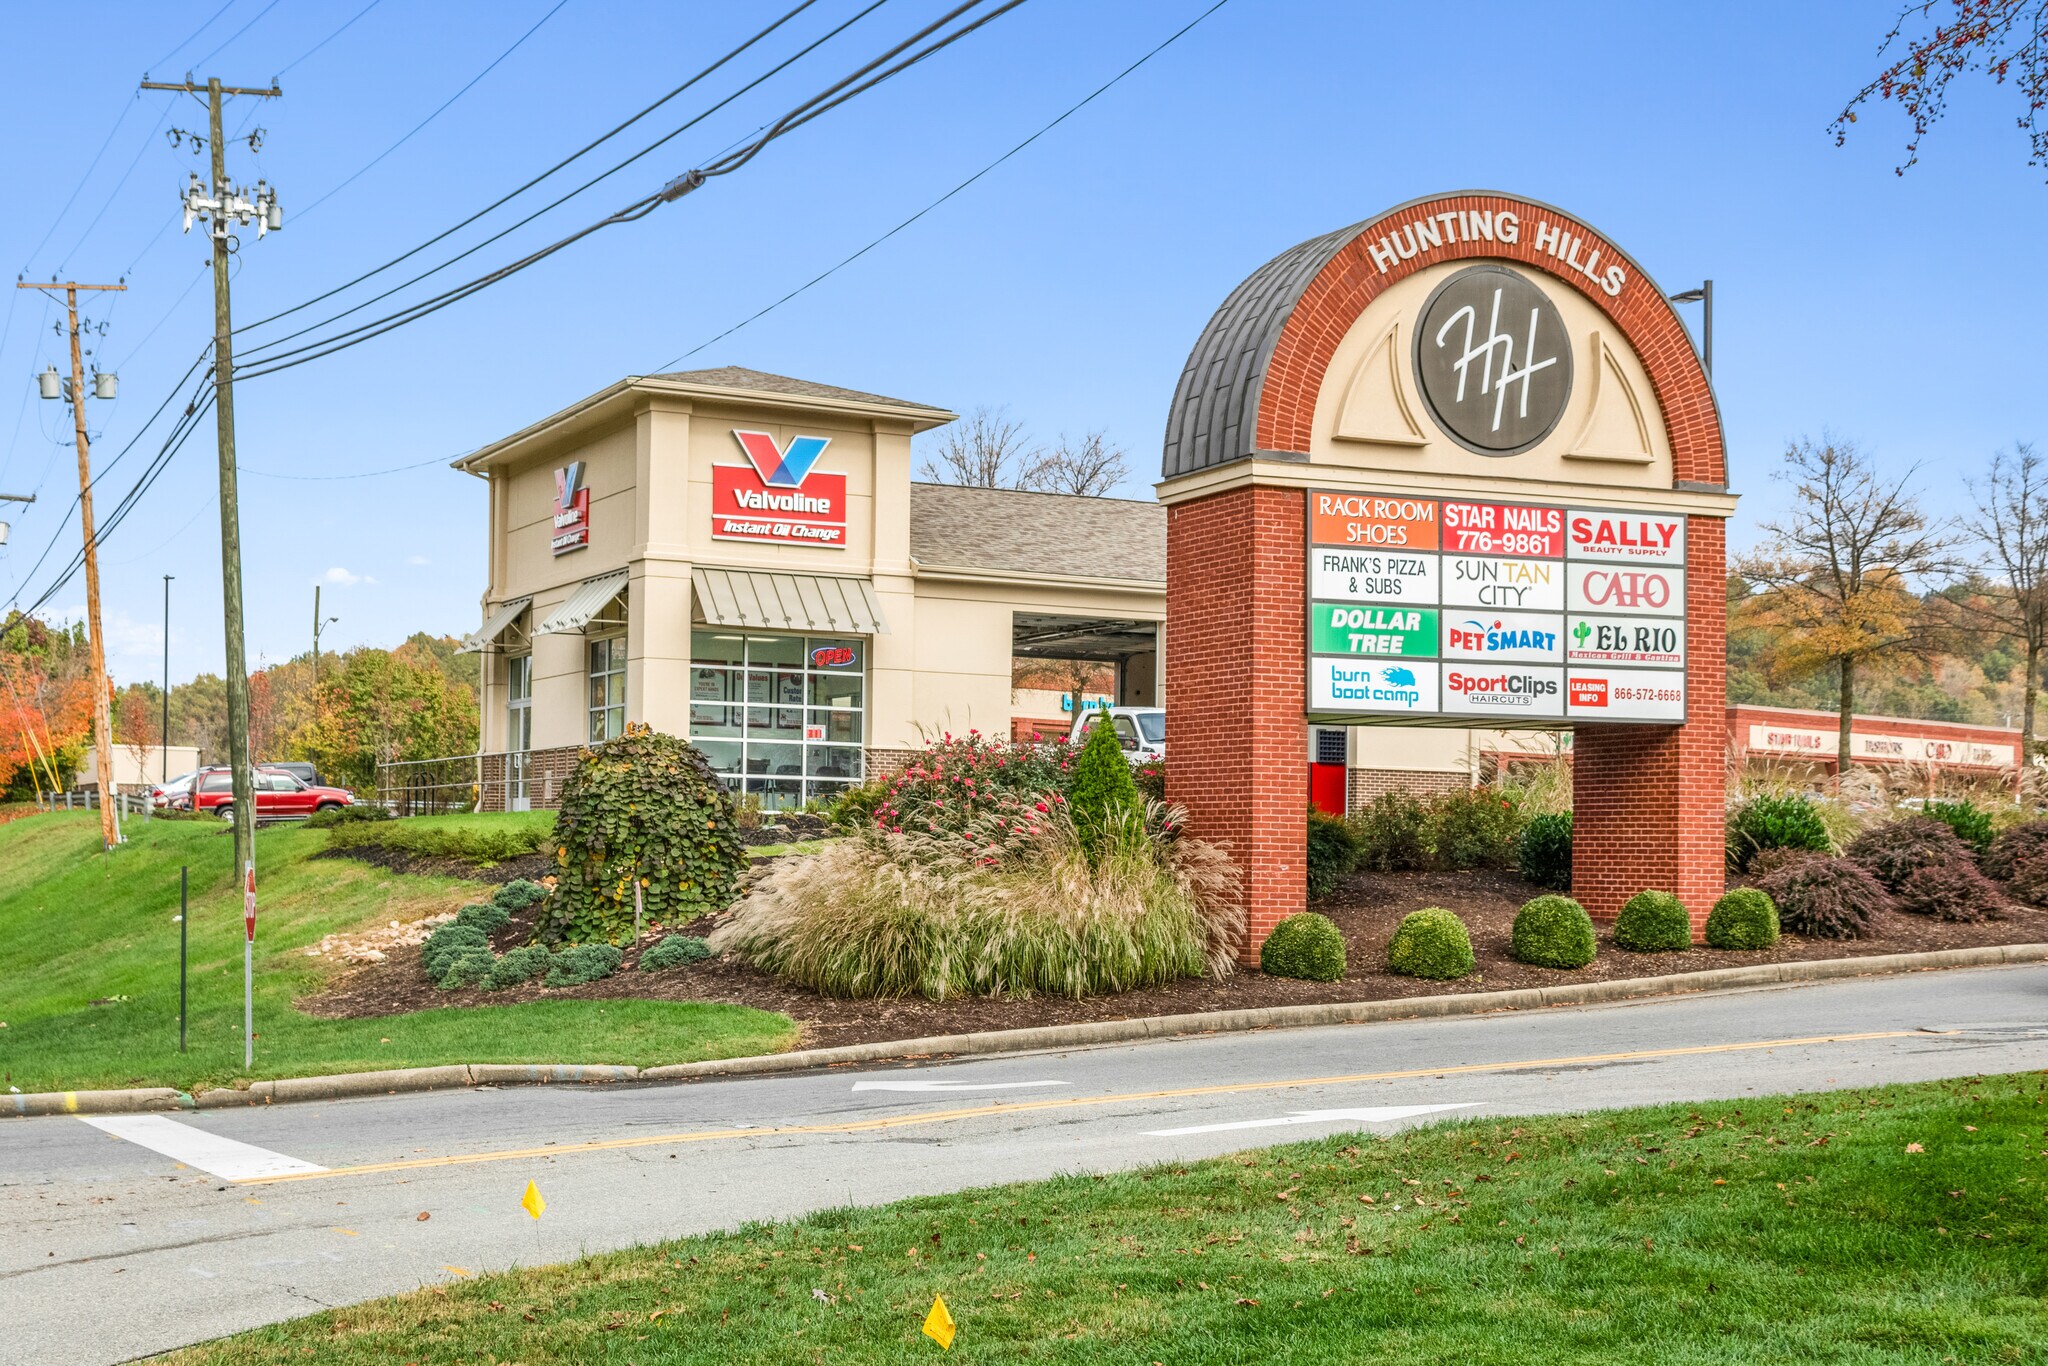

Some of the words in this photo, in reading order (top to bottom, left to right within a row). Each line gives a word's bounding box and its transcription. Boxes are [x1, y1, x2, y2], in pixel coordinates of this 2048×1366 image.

[1367, 210, 1519, 275] HUNTING
[1534, 221, 1626, 297] HILLS
[733, 488, 831, 514] Valvoline
[1319, 495, 1371, 518] RACK
[1374, 499, 1434, 522] ROOM
[1445, 504, 1495, 529] STAR
[1503, 508, 1561, 533] NAILS
[723, 520, 772, 535] Instant
[772, 523, 791, 537] Oil
[791, 525, 841, 541] Change
[1346, 522, 1408, 545] SHOES
[1571, 517, 1678, 548] SALLY
[1456, 530, 1550, 555] 776-9861
[1583, 546, 1623, 554] BEAUTY
[1628, 548, 1667, 557] SUPPLY
[1323, 555, 1382, 574] FRANK'S
[1387, 558, 1427, 577] PIZZA
[1455, 560, 1498, 582] SUN
[1502, 563, 1550, 584] TAN
[1349, 576, 1358, 593] &
[1365, 577, 1402, 595] SUBS
[1478, 585, 1528, 606] CITY
[1582, 570, 1670, 608] CATO
[1330, 608, 1422, 631] DOLLAR
[1347, 633, 1405, 654] TREE
[1596, 625, 1628, 651] EL
[1633, 626, 1677, 653] RIO
[815, 648, 852, 667] OPEN
[1571, 651, 1608, 660] Mexican
[1610, 652, 1632, 661] Grill
[1635, 653, 1642, 661] &
[1644, 653, 1680, 662] Cantina
[1331, 665, 1371, 683] burn
[1331, 682, 1370, 699] boot
[1373, 689, 1419, 708] camp
[1571, 683, 1606, 692] LEASING
[1579, 693, 1598, 702] INFO
[1614, 688, 1682, 701] 866-572-6668
[1062, 693, 1098, 711] brn
[1471, 696, 1530, 704] HAIRCUTS
